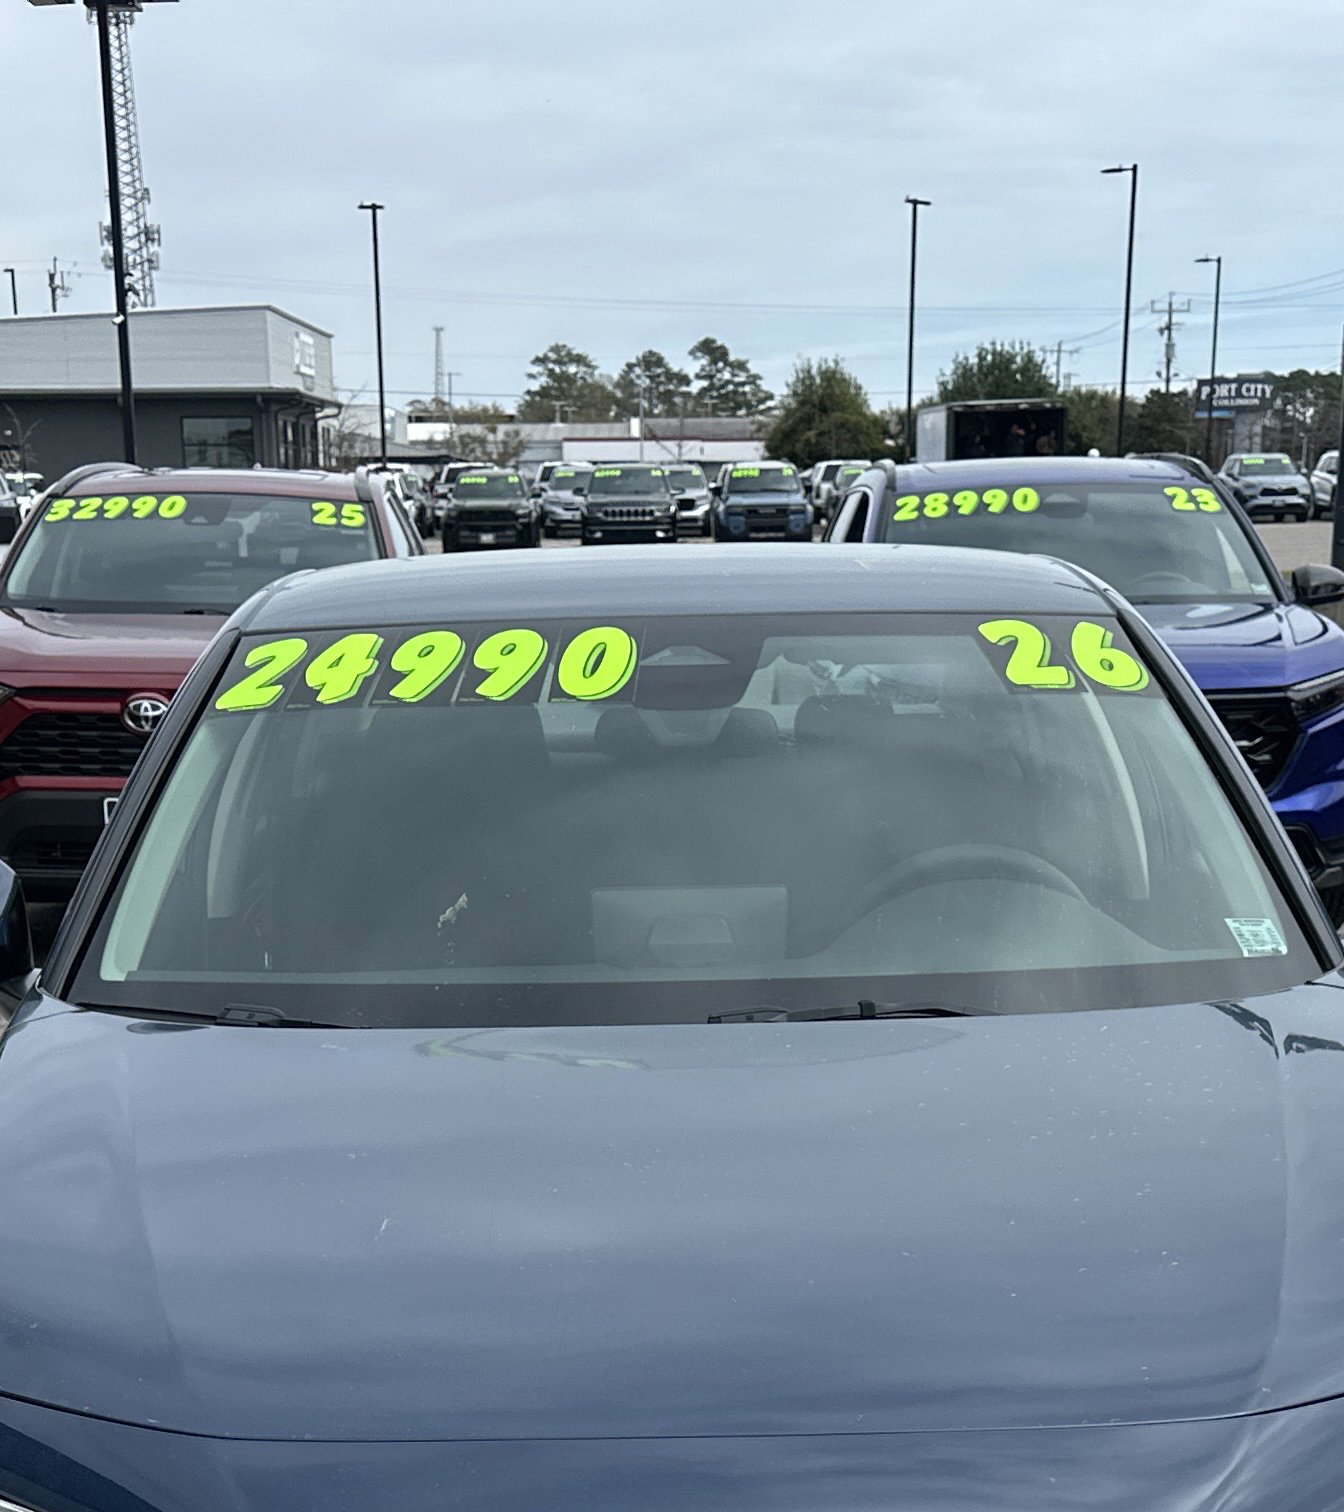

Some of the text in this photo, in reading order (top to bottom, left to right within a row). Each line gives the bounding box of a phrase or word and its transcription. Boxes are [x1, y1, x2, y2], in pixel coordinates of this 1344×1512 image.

[1241, 382, 1274, 399] CITY
[44, 495, 366, 528] 32990 25
[893, 486, 1223, 522] 28990 23
[214, 618, 1150, 712] 24990 26
